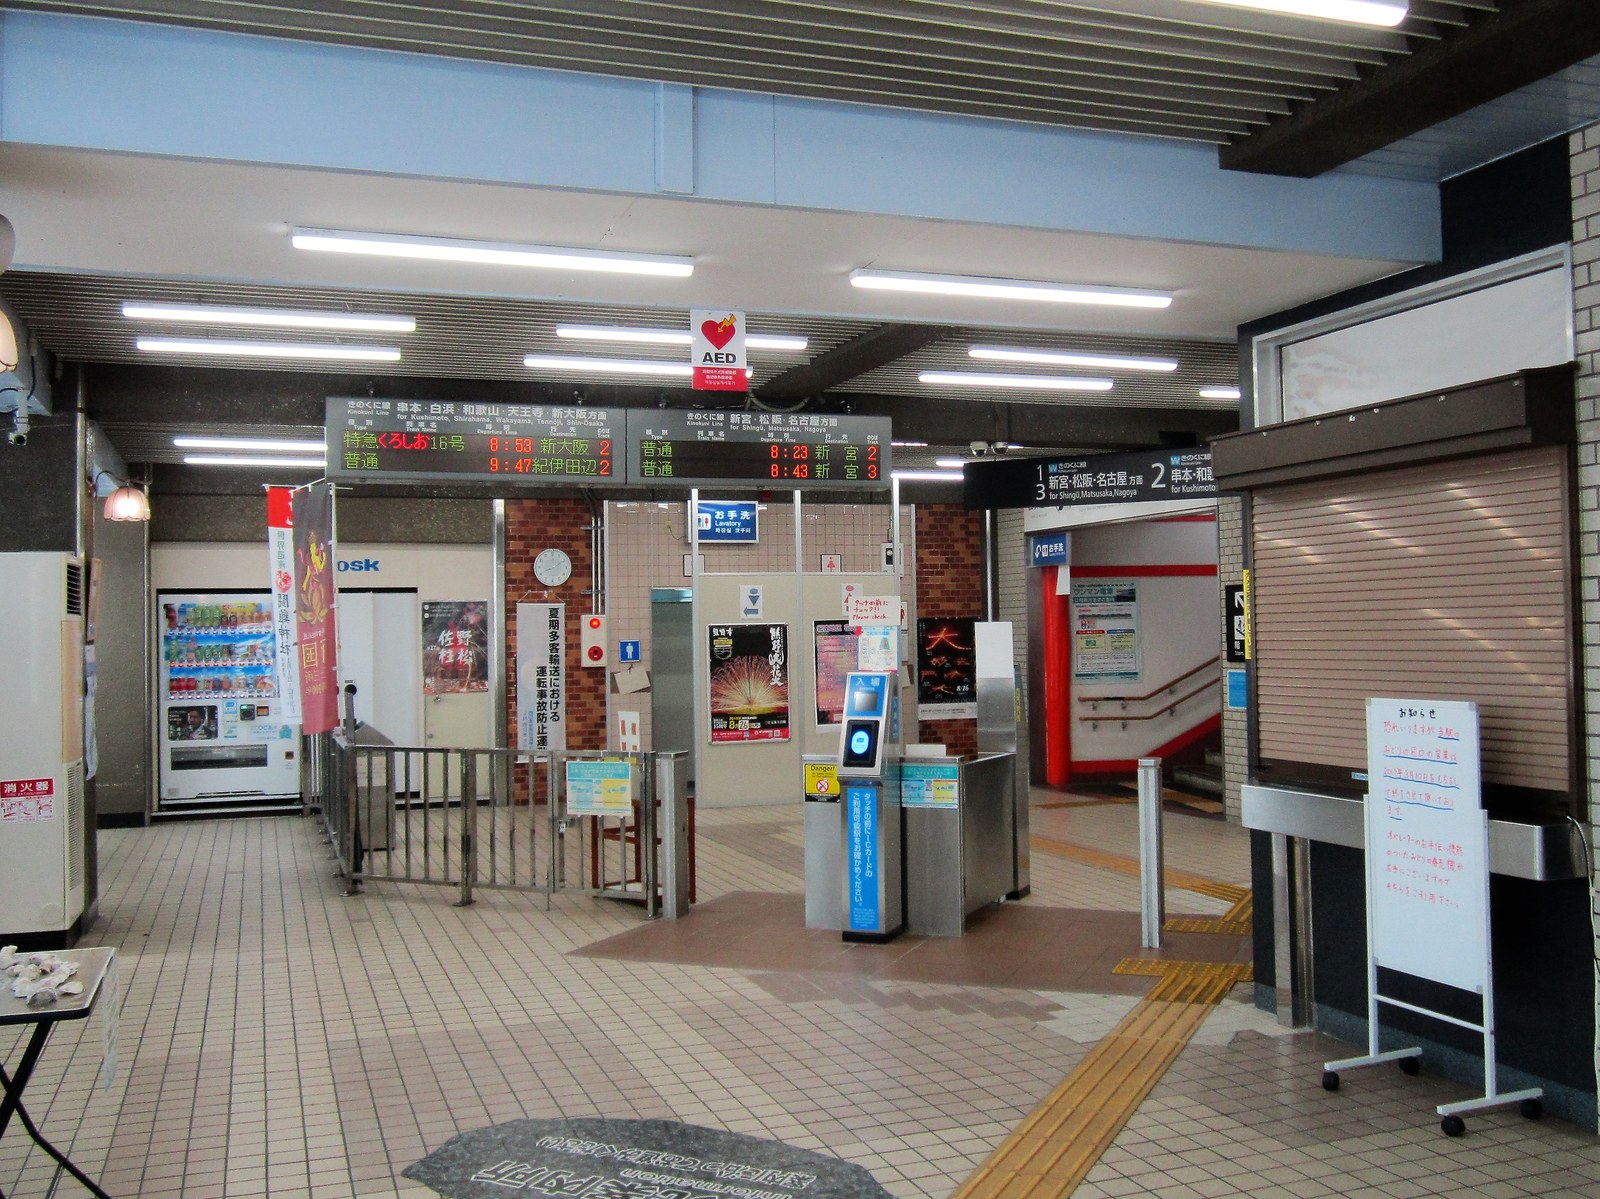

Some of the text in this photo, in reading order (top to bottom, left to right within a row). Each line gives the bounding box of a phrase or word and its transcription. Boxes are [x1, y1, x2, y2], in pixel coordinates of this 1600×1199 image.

[702, 352, 737, 364] AED
[411, 414, 451, 422] Kushimoto,
[454, 415, 492, 423] Shirahama,
[496, 416, 534, 424] Wakayama,
[344, 431, 378, 449] 特急
[490, 437, 533, 453] 8:53
[540, 438, 590, 456] 新大阪
[599, 440, 610, 456] 2
[641, 441, 673, 457] 普通
[770, 445, 809, 460] 8:23
[867, 446, 878, 461] 2
[344, 451, 610, 475] 普通 9:47 紀伊田辺 2
[641, 460, 673, 476] 普通
[770, 463, 809, 478] 8:43
[867, 464, 878, 479] 3
[1036, 464, 1043, 481] 1
[1151, 462, 1166, 489] 2
[1036, 483, 1046, 500] 3
[1049, 491, 1058, 500] for
[1171, 483, 1216, 494] for Kushimoto
[714, 510, 751, 520] お手洗
[714, 520, 742, 528] Lavatory
[437, 630, 473, 647] 佐野
[548, 607, 561, 722] 夏期多客輸送における
[855, 677, 881, 687] 入場
[536, 665, 548, 755] 運転事故防止運
[1399, 707, 1437, 719] お知らせ
[4, 781, 50, 794] 消火器
